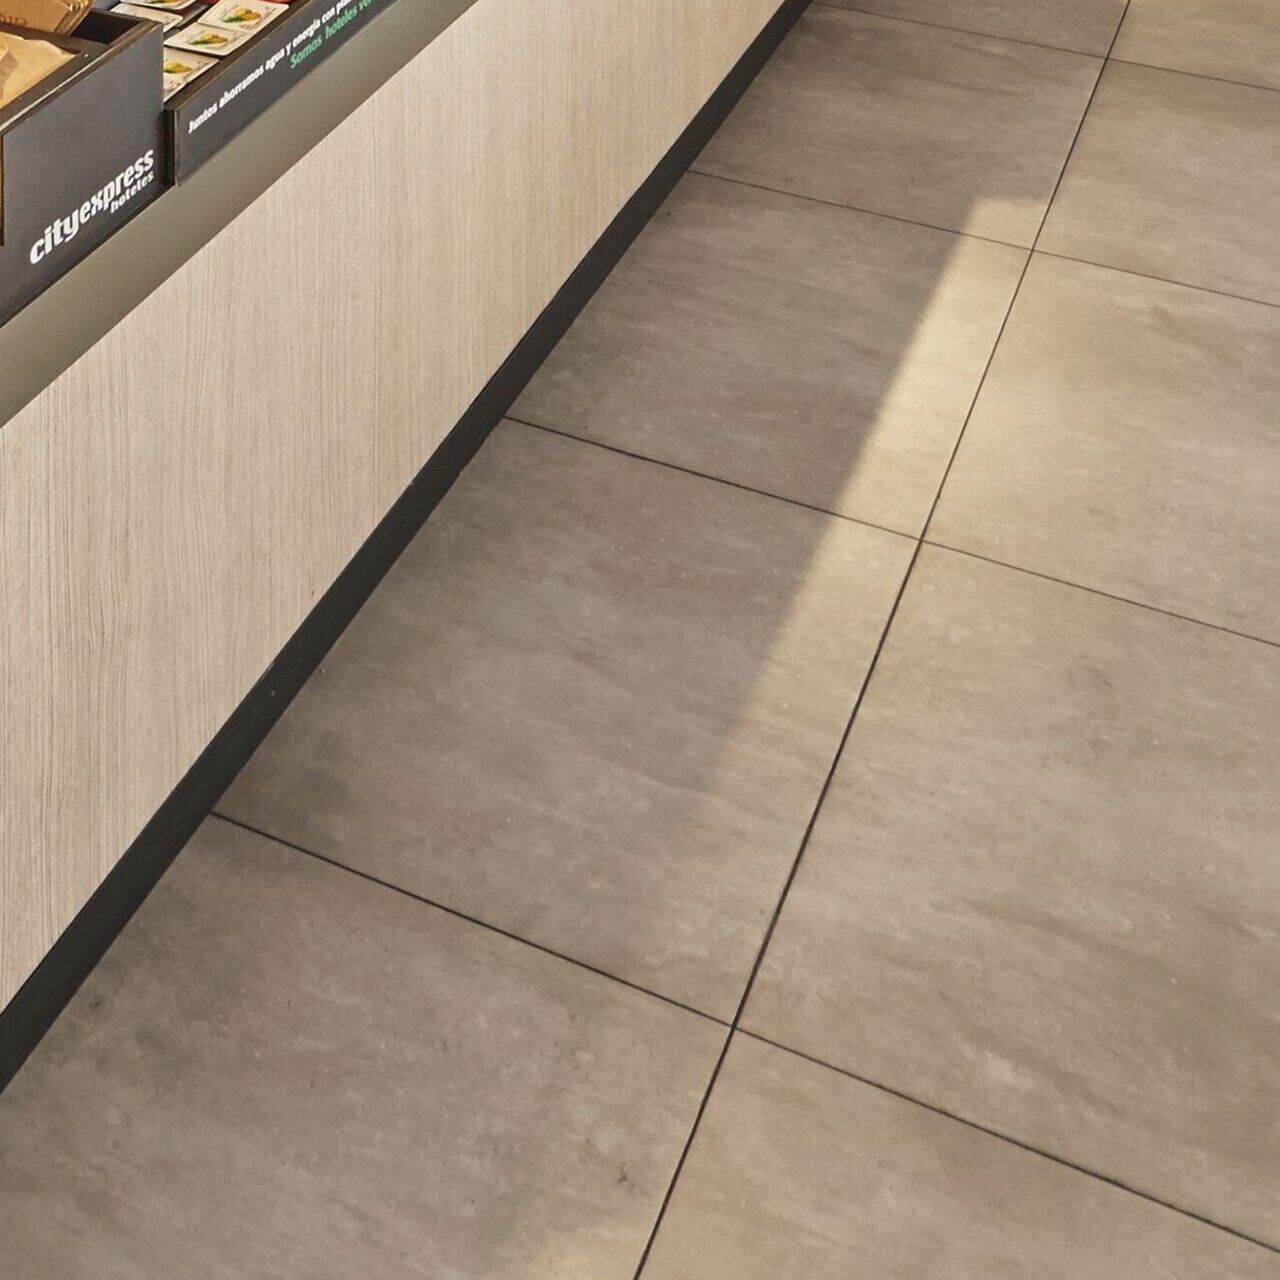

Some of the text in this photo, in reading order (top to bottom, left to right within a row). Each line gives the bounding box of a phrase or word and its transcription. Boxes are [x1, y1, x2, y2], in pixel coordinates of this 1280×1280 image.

[290, 35, 322, 69] Somos
[325, 6, 358, 39] hoteles
[188, 102, 218, 134] Juntos
[219, 65, 264, 108] ahorramos
[265, 48, 285, 70] agua
[285, 42, 291, 55] y
[321, 7, 336, 23] con
[110, 171, 154, 213] hoteles
